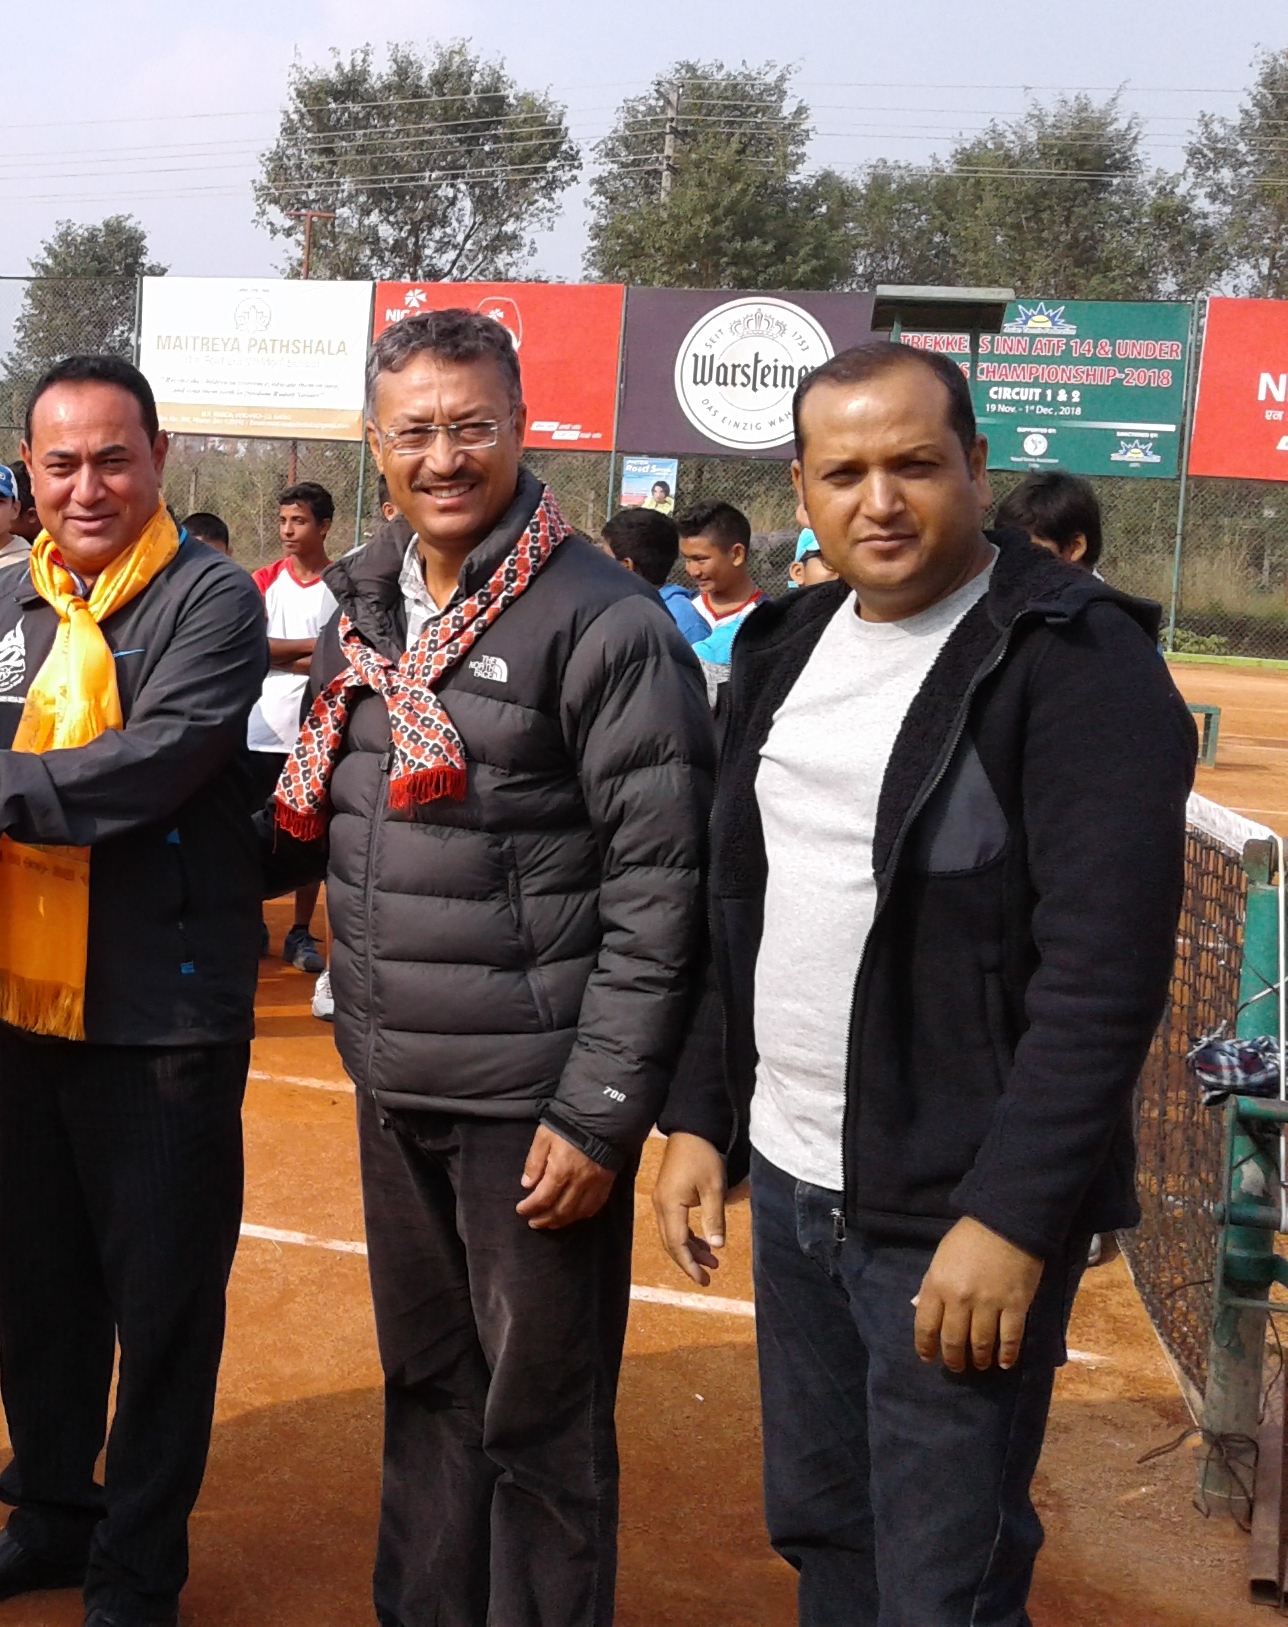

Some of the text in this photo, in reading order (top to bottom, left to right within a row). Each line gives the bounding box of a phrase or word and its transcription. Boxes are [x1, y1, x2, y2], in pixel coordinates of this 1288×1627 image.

[156, 335, 348, 356] MAITREYA PATHSHALA
[704, 328, 810, 352] SEIT 1753
[900, 333, 1182, 360] TREKKES INN ATF 14 & UNDER
[692, 351, 819, 393] Warsteine
[989, 386, 1081, 403] CIRCUIT 1 & 2
[702, 398, 793, 431] DAS EINZIG WAH
[985, 403, 996, 413] 19
[1059, 406, 1082, 416] 2018
[468, 660, 494, 672] NORTH
[482, 654, 497, 664] THE
[602, 1086, 627, 1103] 700
